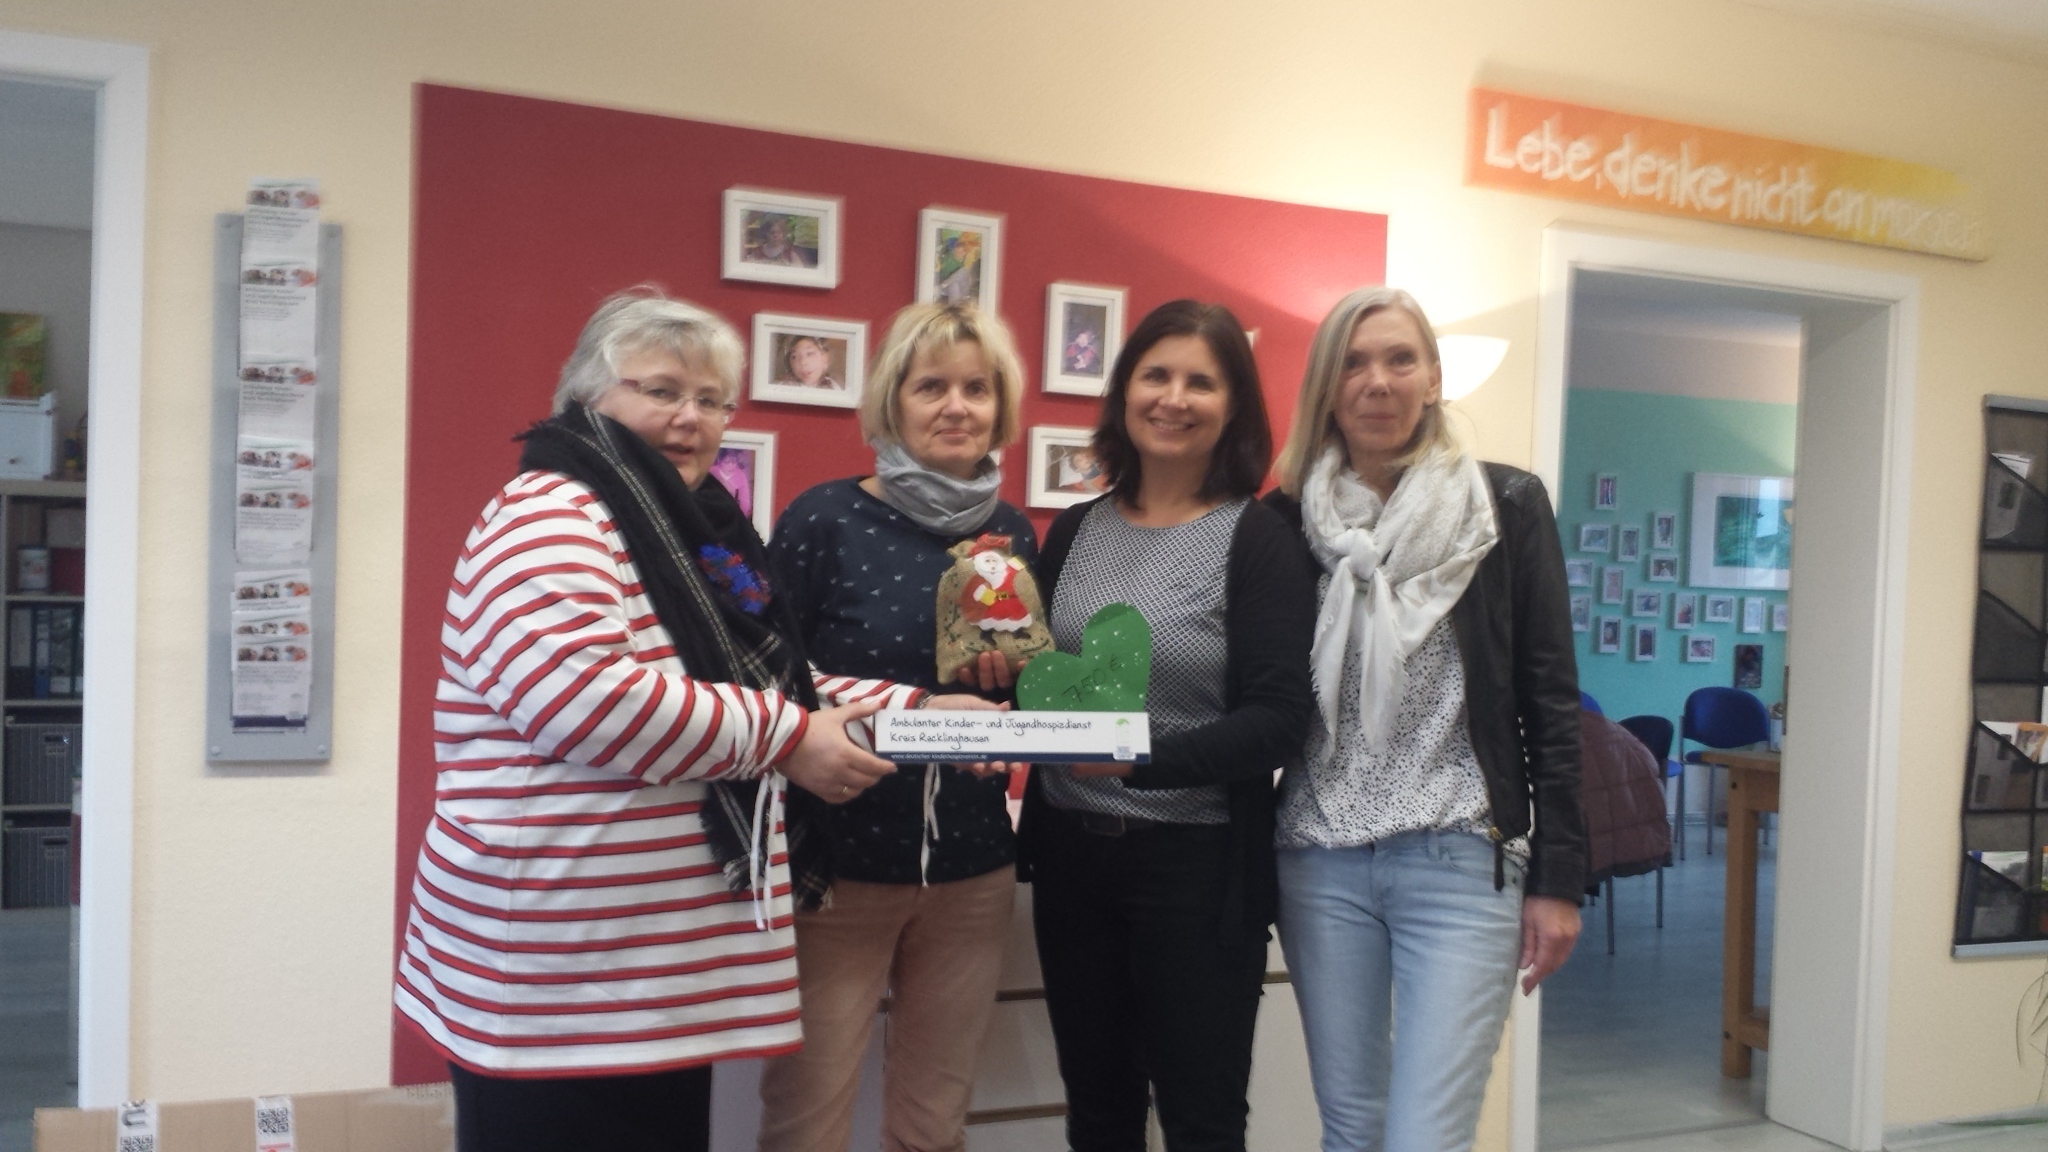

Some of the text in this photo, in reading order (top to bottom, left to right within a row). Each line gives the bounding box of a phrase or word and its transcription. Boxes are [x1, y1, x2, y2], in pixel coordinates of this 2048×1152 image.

[1603, 131, 1728, 212] denke
[1728, 164, 1820, 226] nicht
[1822, 186, 1864, 238] an
[1060, 668, 1106, 703] 750
[889, 716, 1092, 736] Ambulanter Kinder- und Jugendhospizdienst
[889, 731, 990, 750] Kreis Recklinghausen
